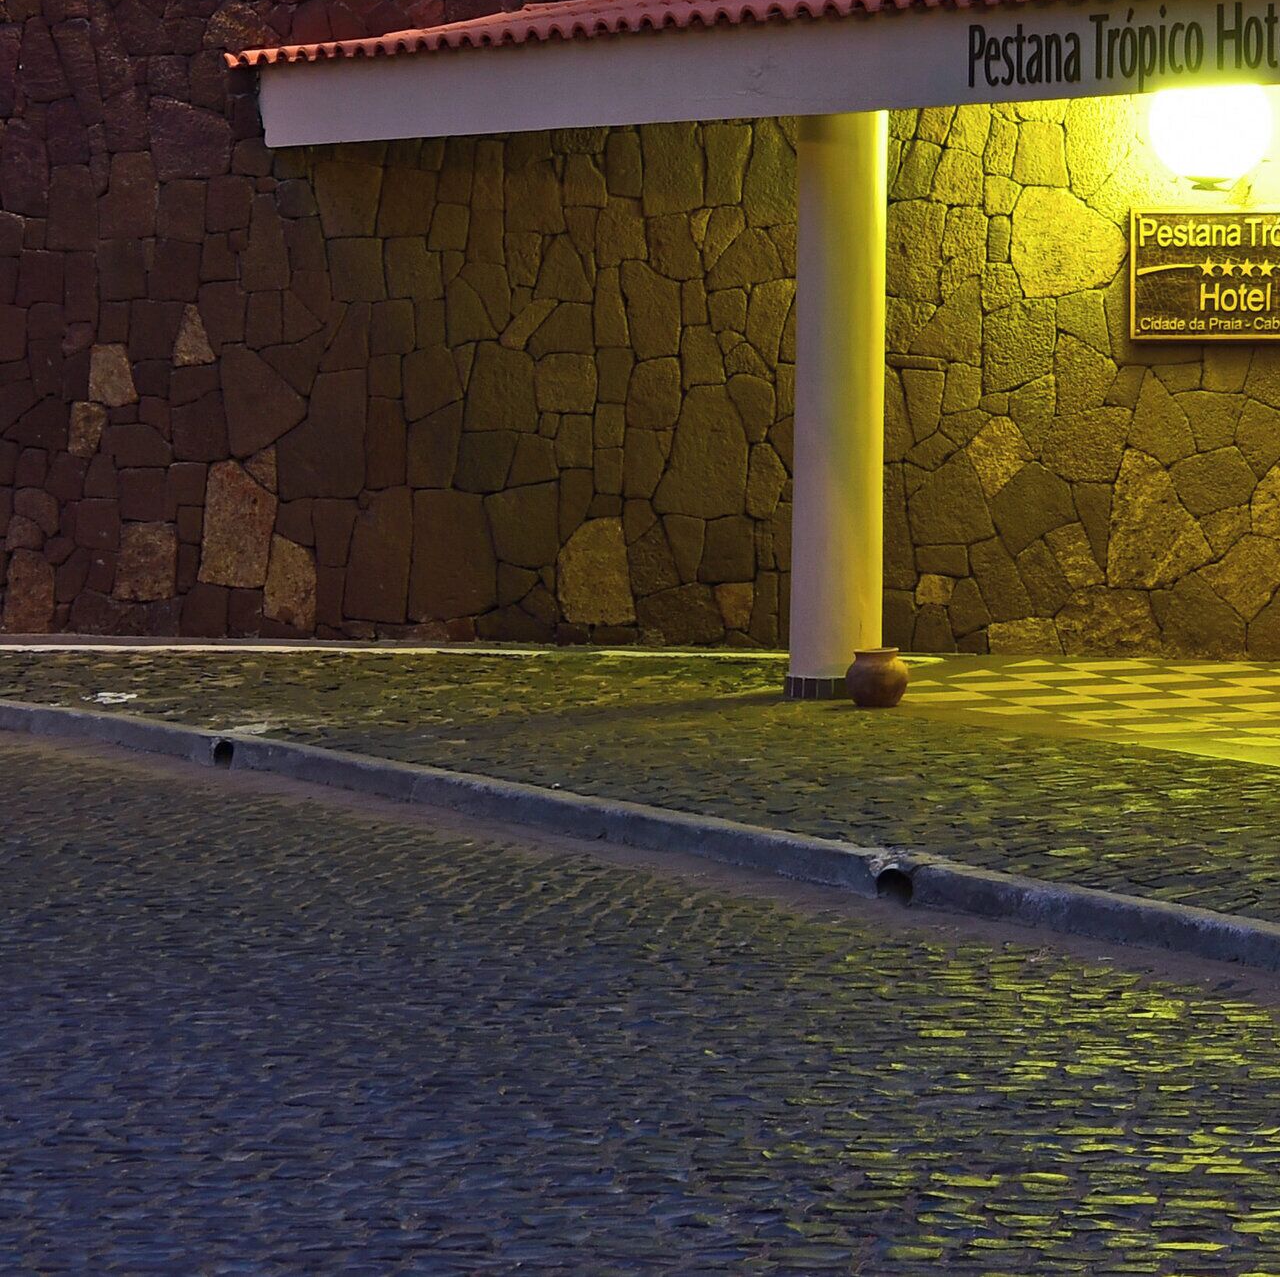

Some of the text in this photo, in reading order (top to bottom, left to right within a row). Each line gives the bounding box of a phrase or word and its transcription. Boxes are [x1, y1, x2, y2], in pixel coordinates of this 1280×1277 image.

[968, 24, 1081, 88] Pestana
[1089, 4, 1204, 92] Trópico
[1139, 218, 1241, 247] Pestana
[1200, 282, 1272, 312] Hotel
[1140, 316, 1185, 331] Cidade
[1190, 317, 1206, 330] da
[1209, 317, 1242, 330] Praia
